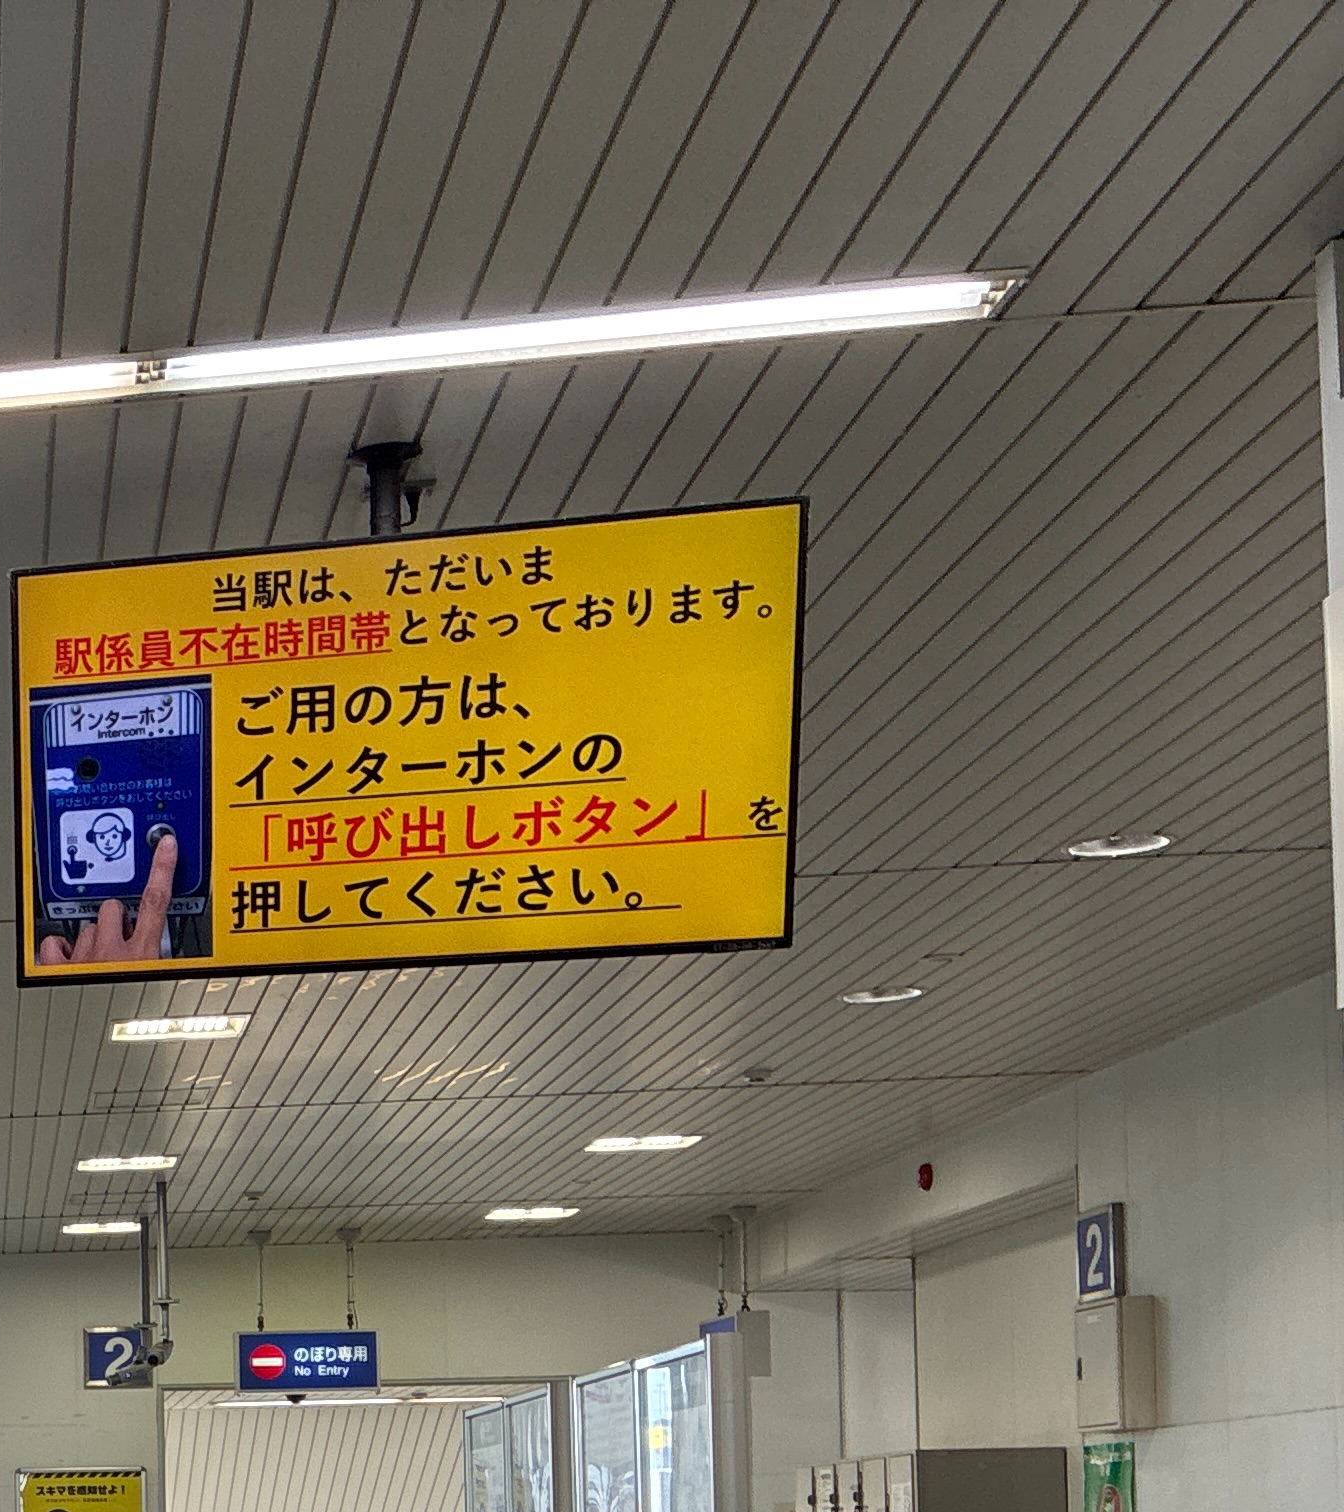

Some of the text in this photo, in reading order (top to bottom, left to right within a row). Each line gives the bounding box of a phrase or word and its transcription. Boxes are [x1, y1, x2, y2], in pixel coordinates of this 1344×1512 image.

[211, 546, 555, 613] 当駅は、ただいま
[54, 579, 775, 676] 駅係員不在時間帯となっております。
[70, 706, 174, 732] インターホン
[98, 727, 146, 739] Intercom
[235, 675, 537, 738] ご用の方は、
[233, 731, 624, 799] インターホンの
[231, 862, 649, 931] 押してください。
[1085, 1222, 1103, 1287] 2
[104, 1337, 135, 1384] 2
[294, 1364, 350, 1378] No Entry
